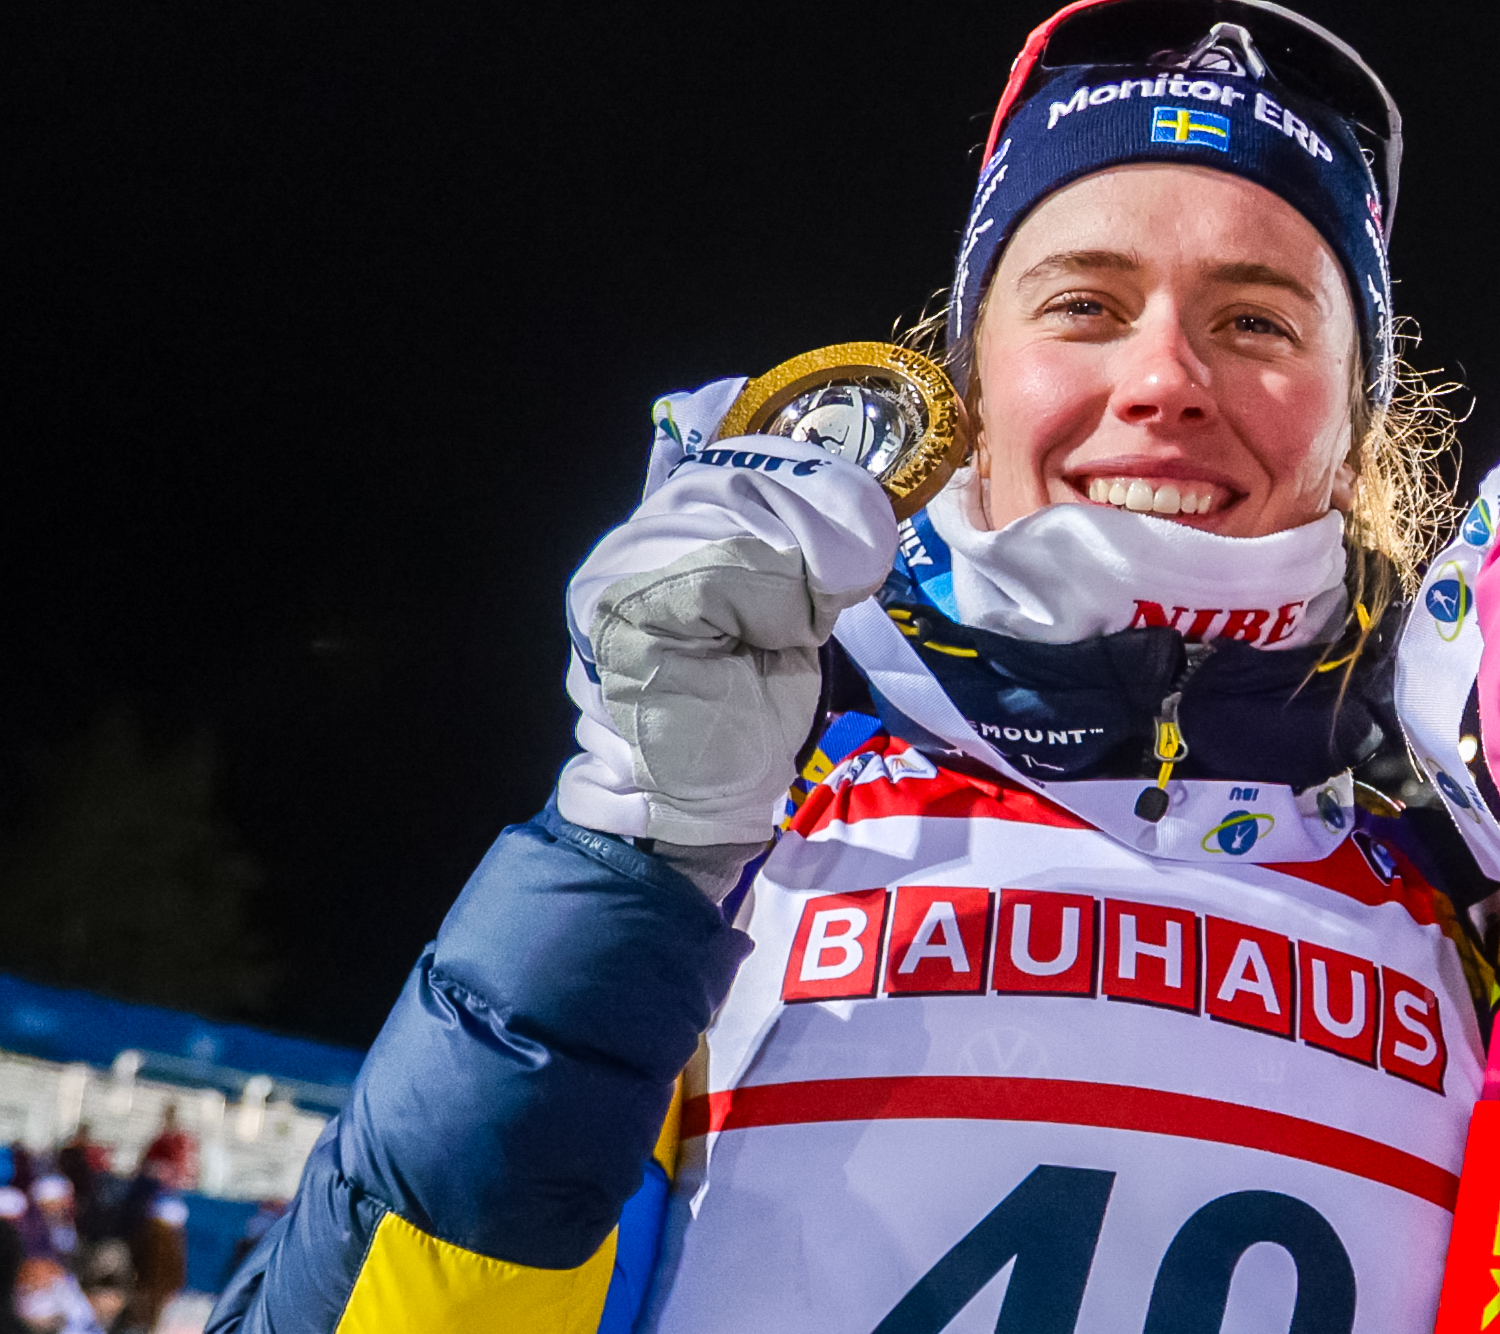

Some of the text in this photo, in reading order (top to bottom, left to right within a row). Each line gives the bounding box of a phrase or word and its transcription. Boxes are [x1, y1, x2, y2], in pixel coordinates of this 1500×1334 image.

[1047, 73, 1333, 163] Monitor ERP
[1129, 600, 1305, 650] NIBE
[1228, 787, 1259, 801] IBU
[798, 899, 1439, 1067] BAUHAUS
